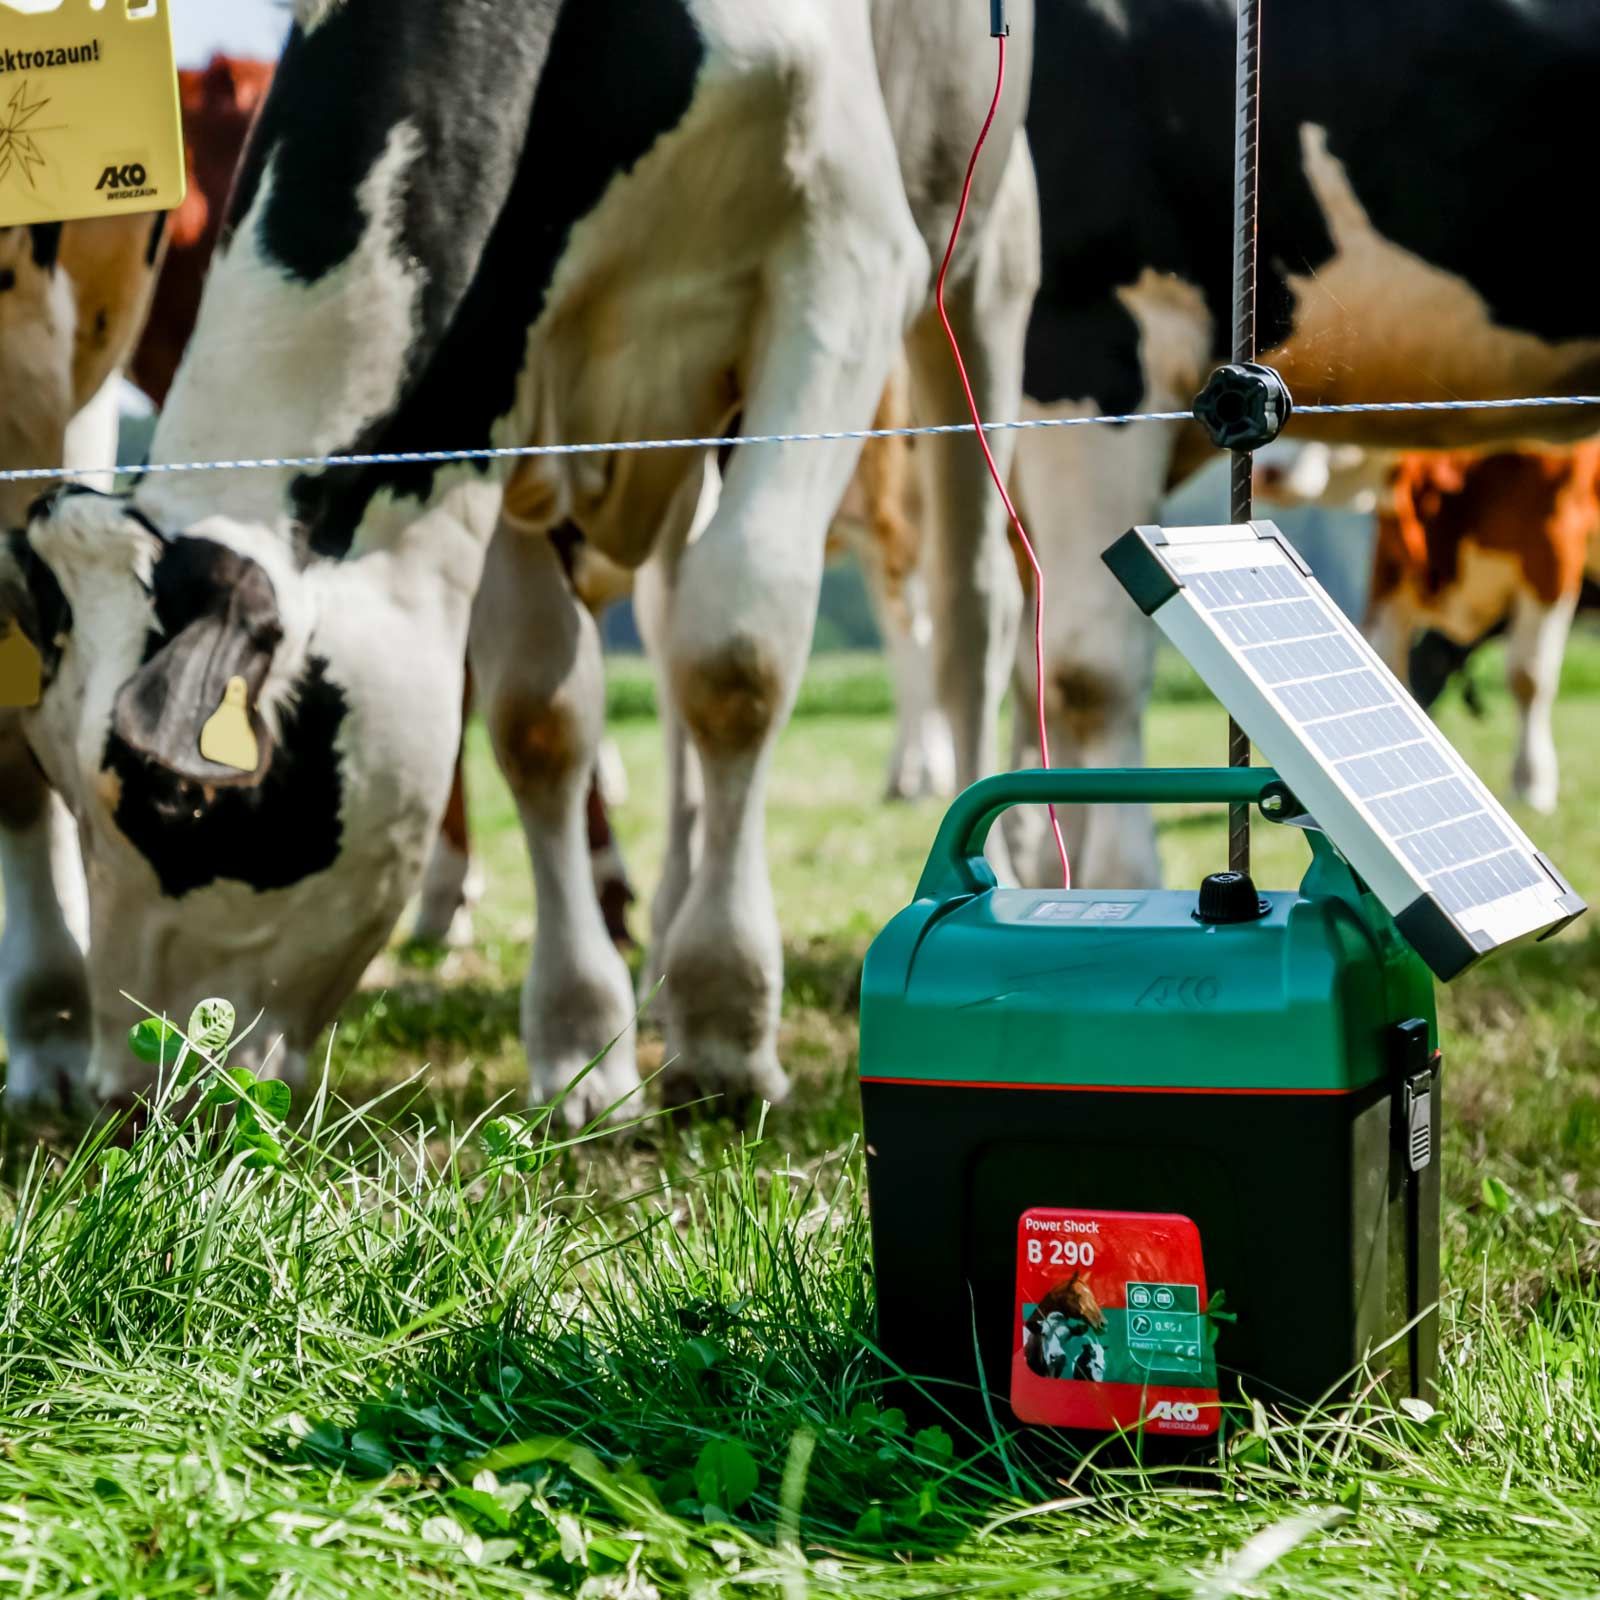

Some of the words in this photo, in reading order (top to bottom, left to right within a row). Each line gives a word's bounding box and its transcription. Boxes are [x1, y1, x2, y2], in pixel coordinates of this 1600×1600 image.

[95, 163, 147, 190] AKO
[106, 187, 158, 201] WEIDEZAUN
[1025, 1218, 1061, 1232] Power
[1063, 1220, 1100, 1234] Shock
[1027, 1239, 1043, 1264] B
[1049, 1240, 1095, 1267] 290
[1145, 1401, 1199, 1422] AKO
